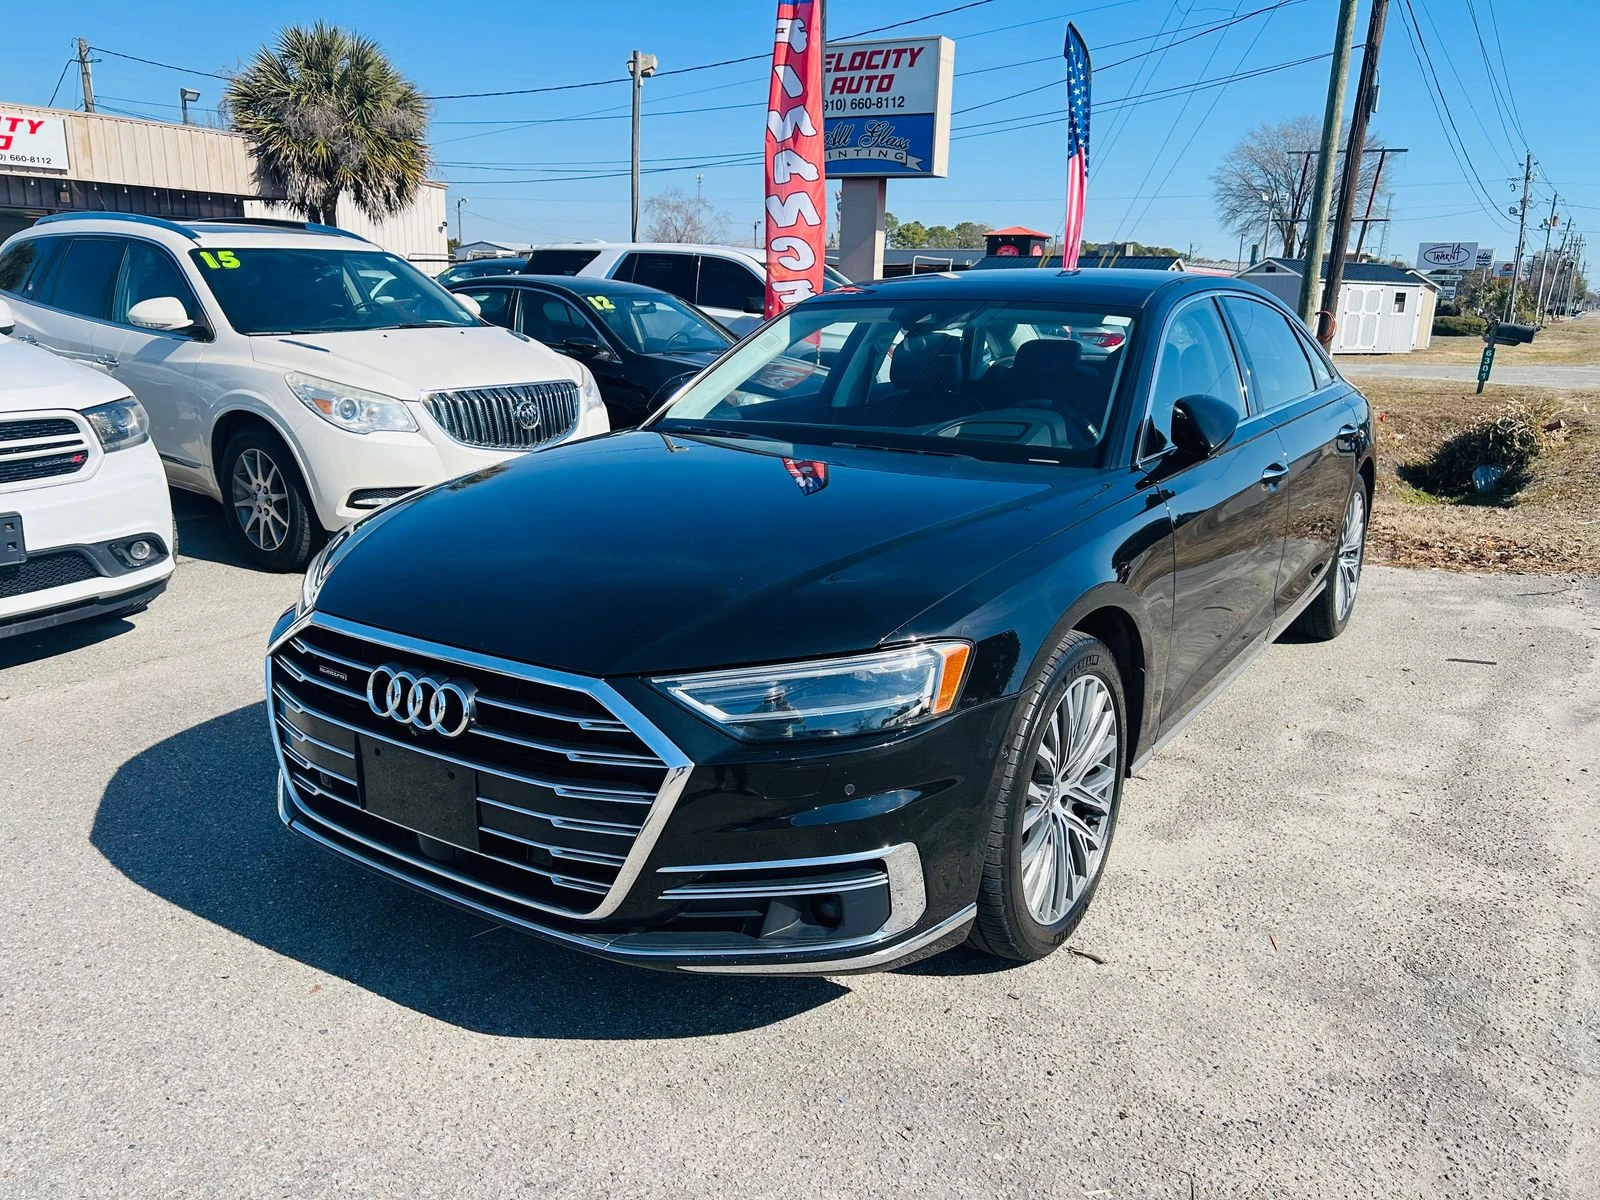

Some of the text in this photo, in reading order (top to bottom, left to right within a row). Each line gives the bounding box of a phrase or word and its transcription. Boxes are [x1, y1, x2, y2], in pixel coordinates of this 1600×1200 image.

[825, 47, 925, 73] ELOCITY
[829, 74, 895, 95] AUTO
[825, 96, 905, 111] 910) 660-8112
[0, 116, 45, 134] TY
[858, 120, 910, 150] Glass
[10, 154, 51, 164] 660-8112
[828, 149, 904, 160] INTING
[200, 251, 241, 269] 15
[587, 296, 616, 310] 12
[1481, 349, 1493, 379] 6301
